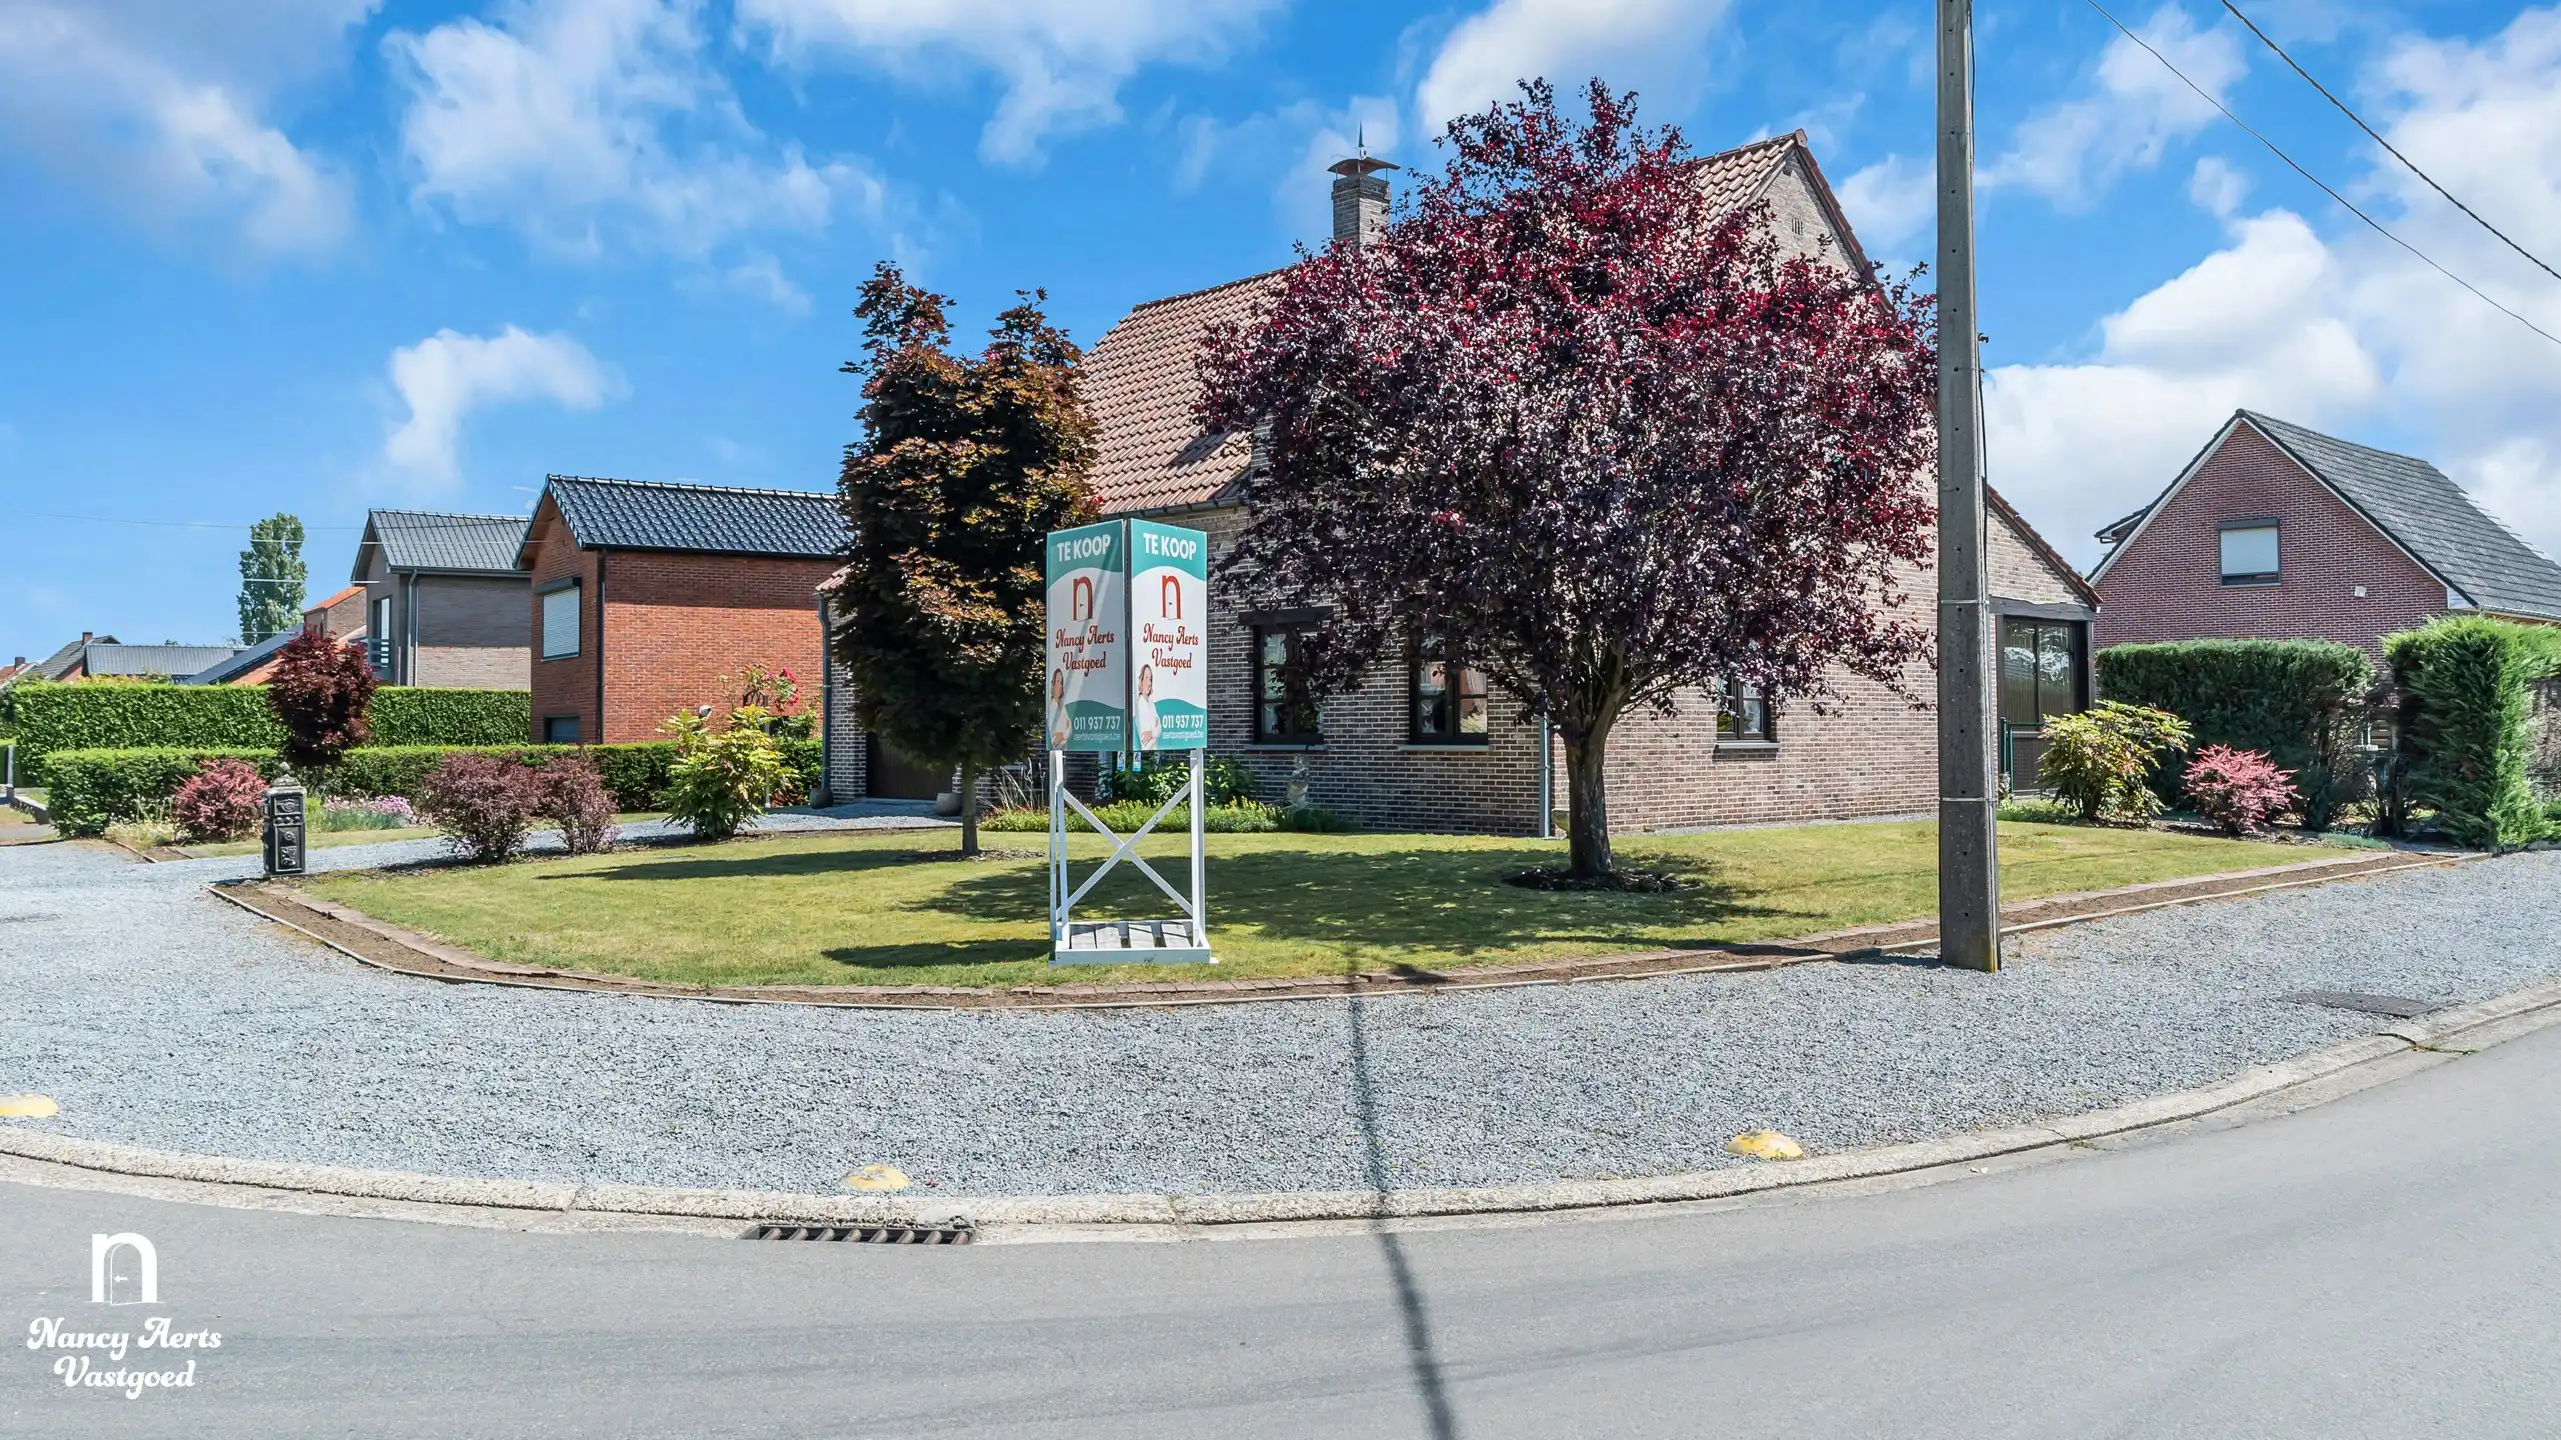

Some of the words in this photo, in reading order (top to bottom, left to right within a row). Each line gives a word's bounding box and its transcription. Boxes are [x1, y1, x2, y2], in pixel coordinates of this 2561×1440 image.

[1057, 541, 1071, 561] TE
[1073, 534, 1111, 559] KOOP
[1143, 533, 1158, 555] TE
[1162, 536, 1196, 560] KOOP
[1055, 628, 1085, 653] Nancy
[1087, 625, 1115, 645] Aerts
[1143, 623, 1173, 651] Nancy
[1176, 626, 1199, 646] Aerts
[1062, 651, 1107, 677] Vastgoed
[1152, 648, 1192, 675] Vastgoed
[1073, 717, 1086, 730] 011
[1088, 717, 1102, 730] 937
[1105, 716, 1121, 730] 737
[1162, 716, 1175, 729] 011
[1176, 715, 1189, 729] 937
[1190, 715, 1204, 728] 737
[1073, 732, 1121, 743] aertsvastgoed.be
[1162, 731, 1204, 742] aertsvastgoed.be
